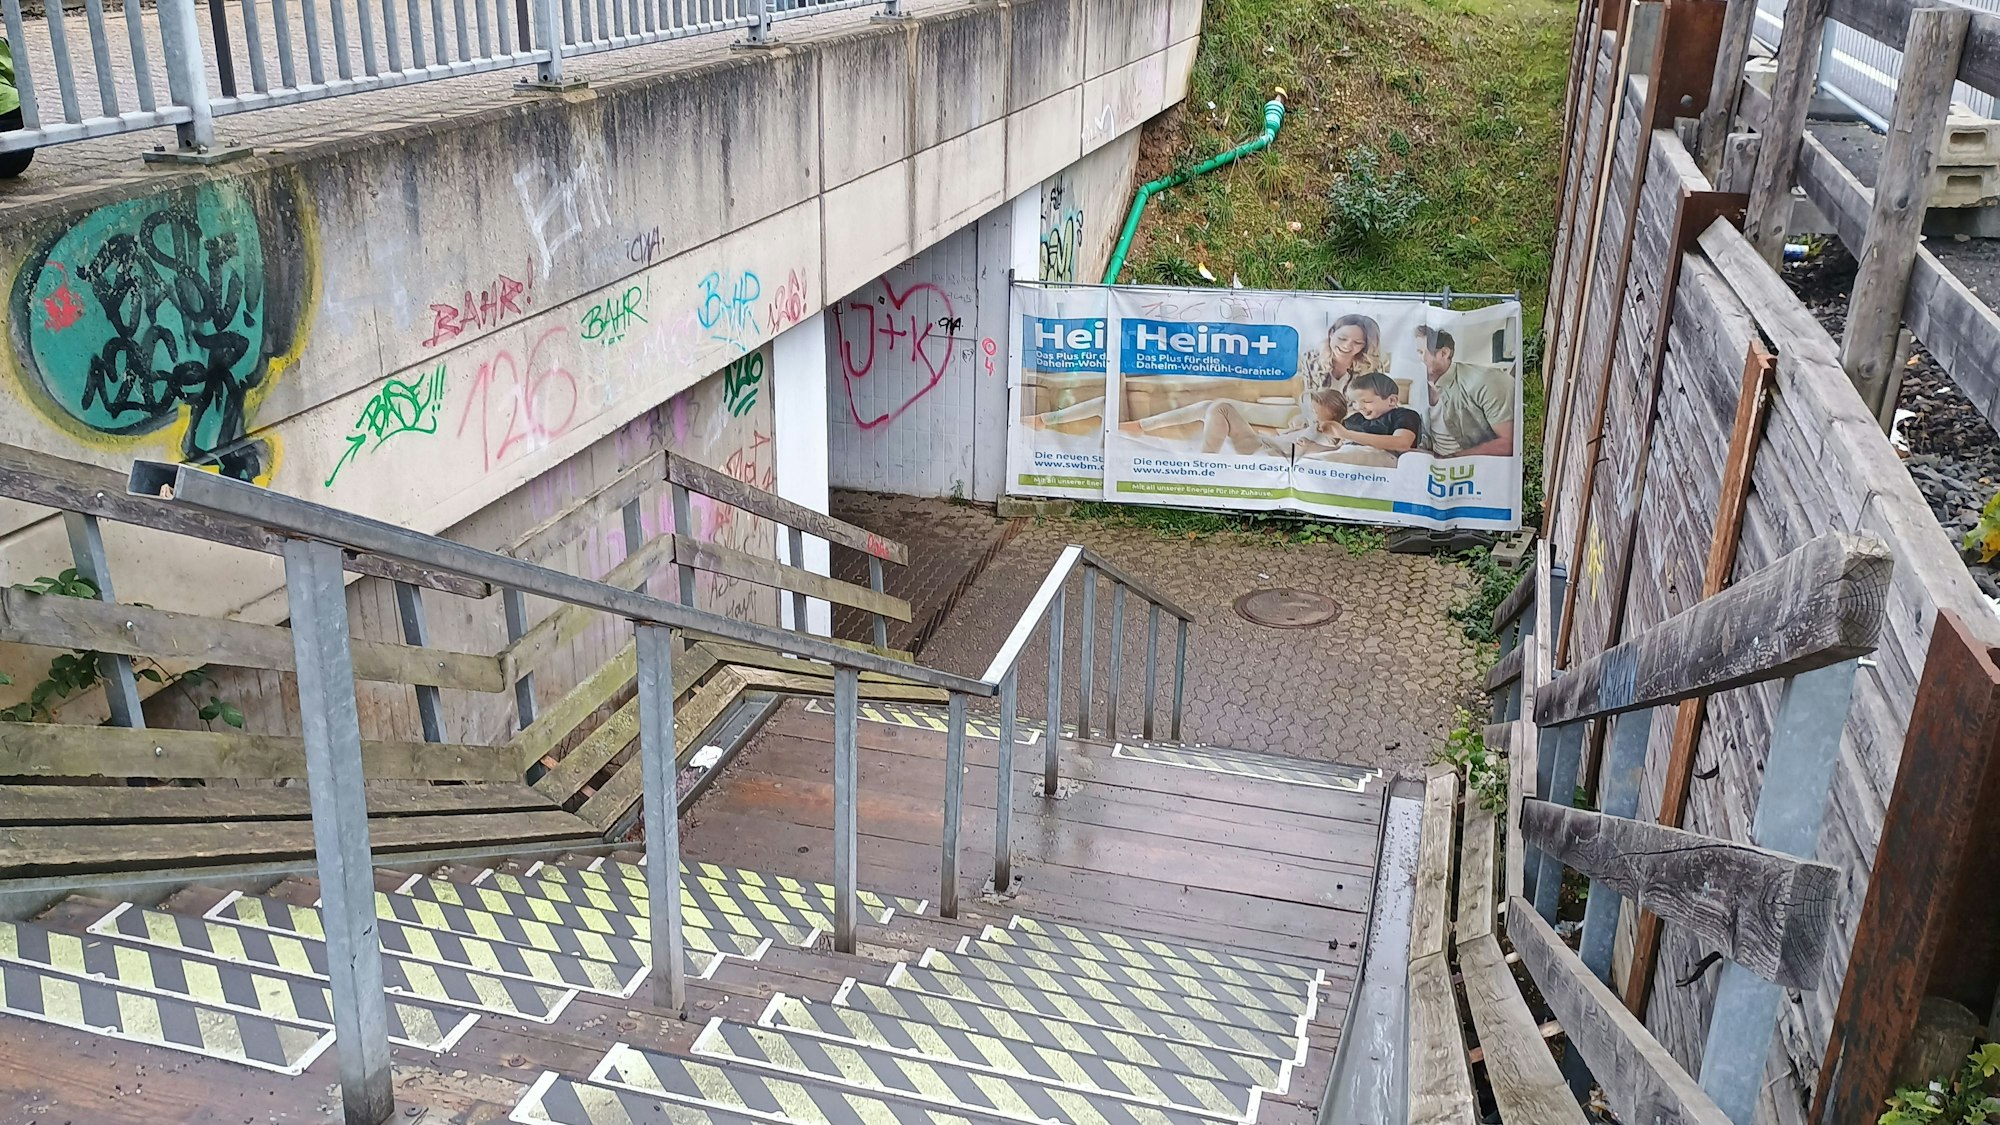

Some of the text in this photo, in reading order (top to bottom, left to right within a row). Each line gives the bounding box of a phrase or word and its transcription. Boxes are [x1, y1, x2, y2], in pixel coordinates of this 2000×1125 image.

[422, 253, 534, 347] BAHR!
[581, 275, 649, 339] BAHR!
[1136, 323, 1277, 356] Heim+
[1036, 350, 1054, 360] Das
[1057, 352, 1079, 361] Plus
[1081, 352, 1098, 361] für
[1136, 353, 1220, 364] Das Plus für die
[1136, 360, 1285, 376] Daheim-Wohlfühl-Garantie.
[457, 325, 577, 473] 126
[1034, 451, 1053, 459] Die
[1056, 453, 1089, 462] neuen
[1132, 467, 1216, 477] www.swbm.de
[1133, 457, 1153, 466] Die
[1155, 459, 1190, 467] neuen
[1192, 460, 1231, 469] Strom-
[1307, 468, 1327, 476] aus
[1330, 469, 1390, 483] Bergheim.
[1186, 486, 1214, 494] Energie
